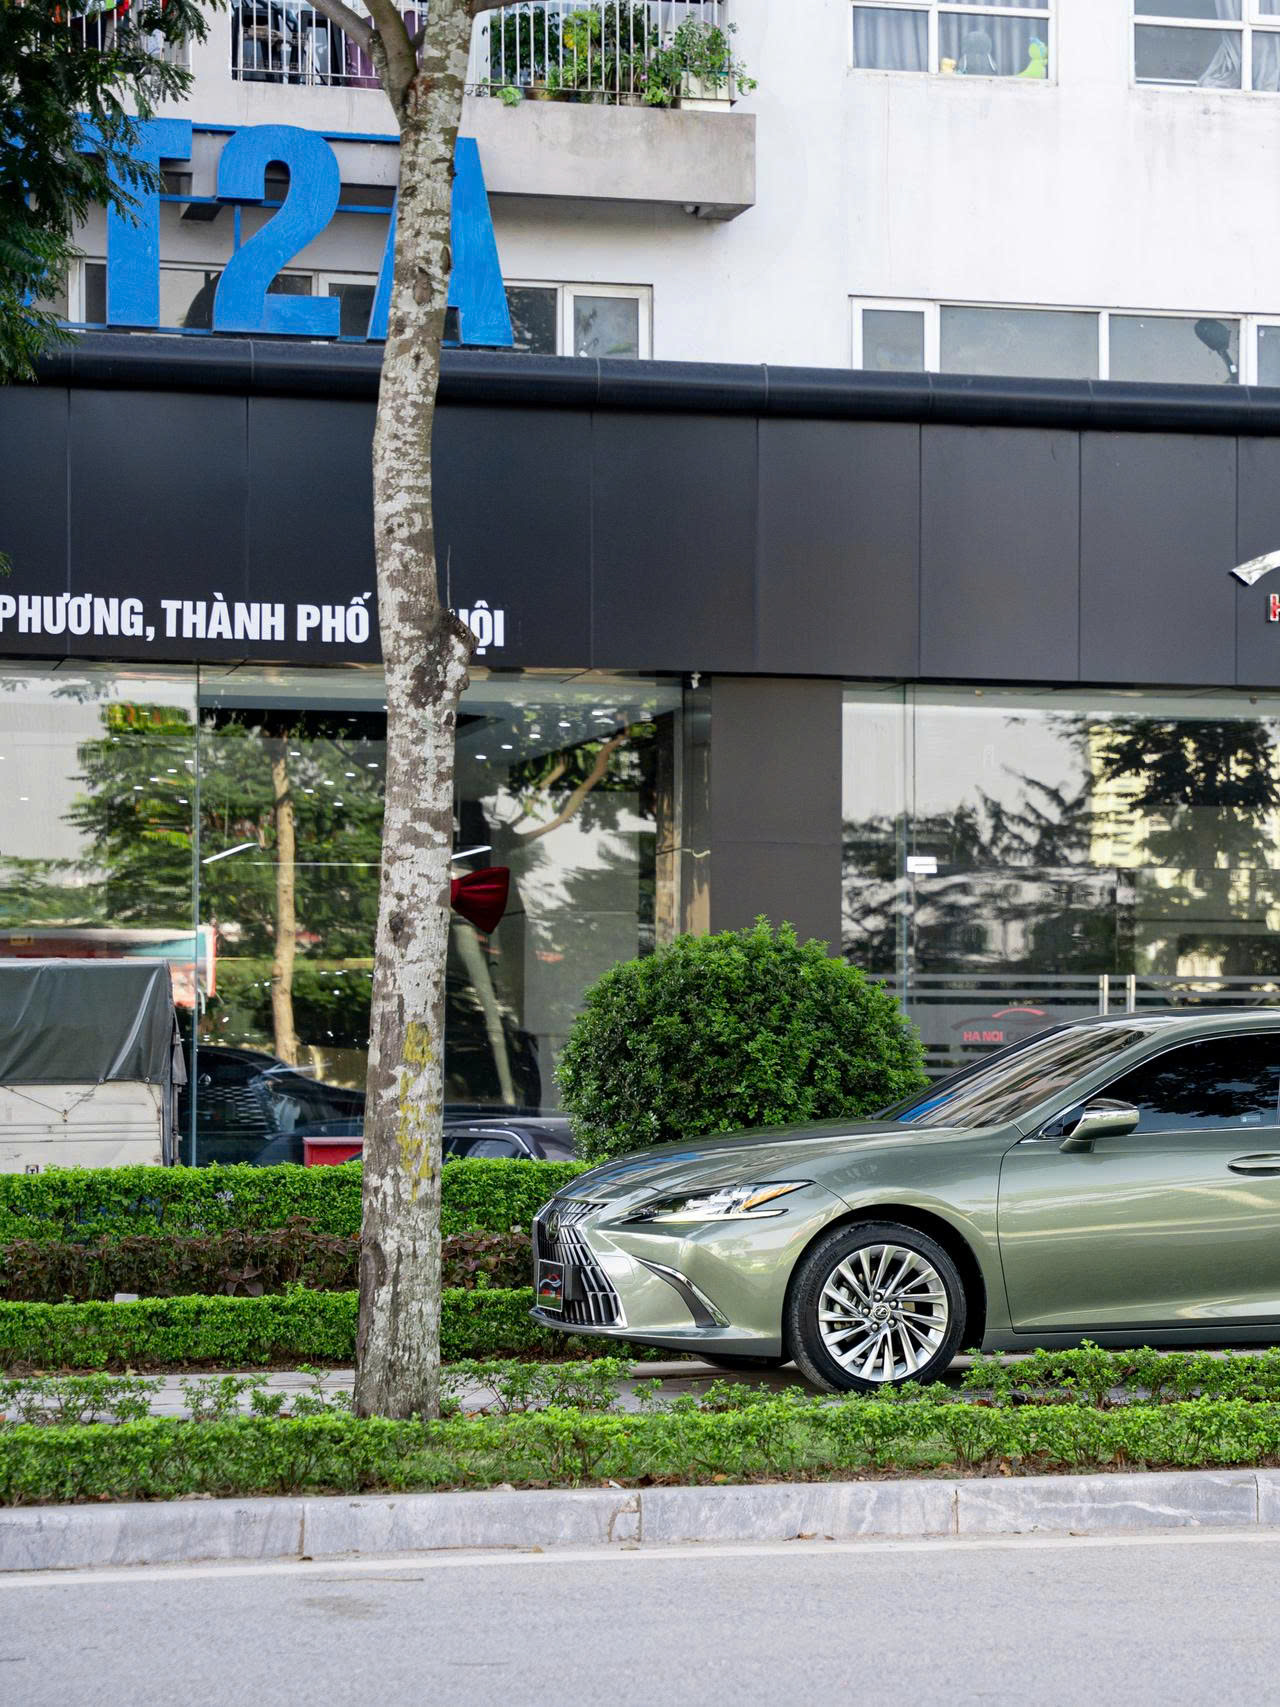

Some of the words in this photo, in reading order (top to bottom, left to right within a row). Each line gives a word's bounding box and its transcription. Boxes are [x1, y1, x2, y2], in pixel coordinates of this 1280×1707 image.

[0, 106, 514, 347] T2A
[0, 593, 156, 642] PHƯƠNG,
[160, 592, 285, 641] THÀNH
[297, 592, 372, 644] PHỐ
[458, 599, 505, 656] ỘI
